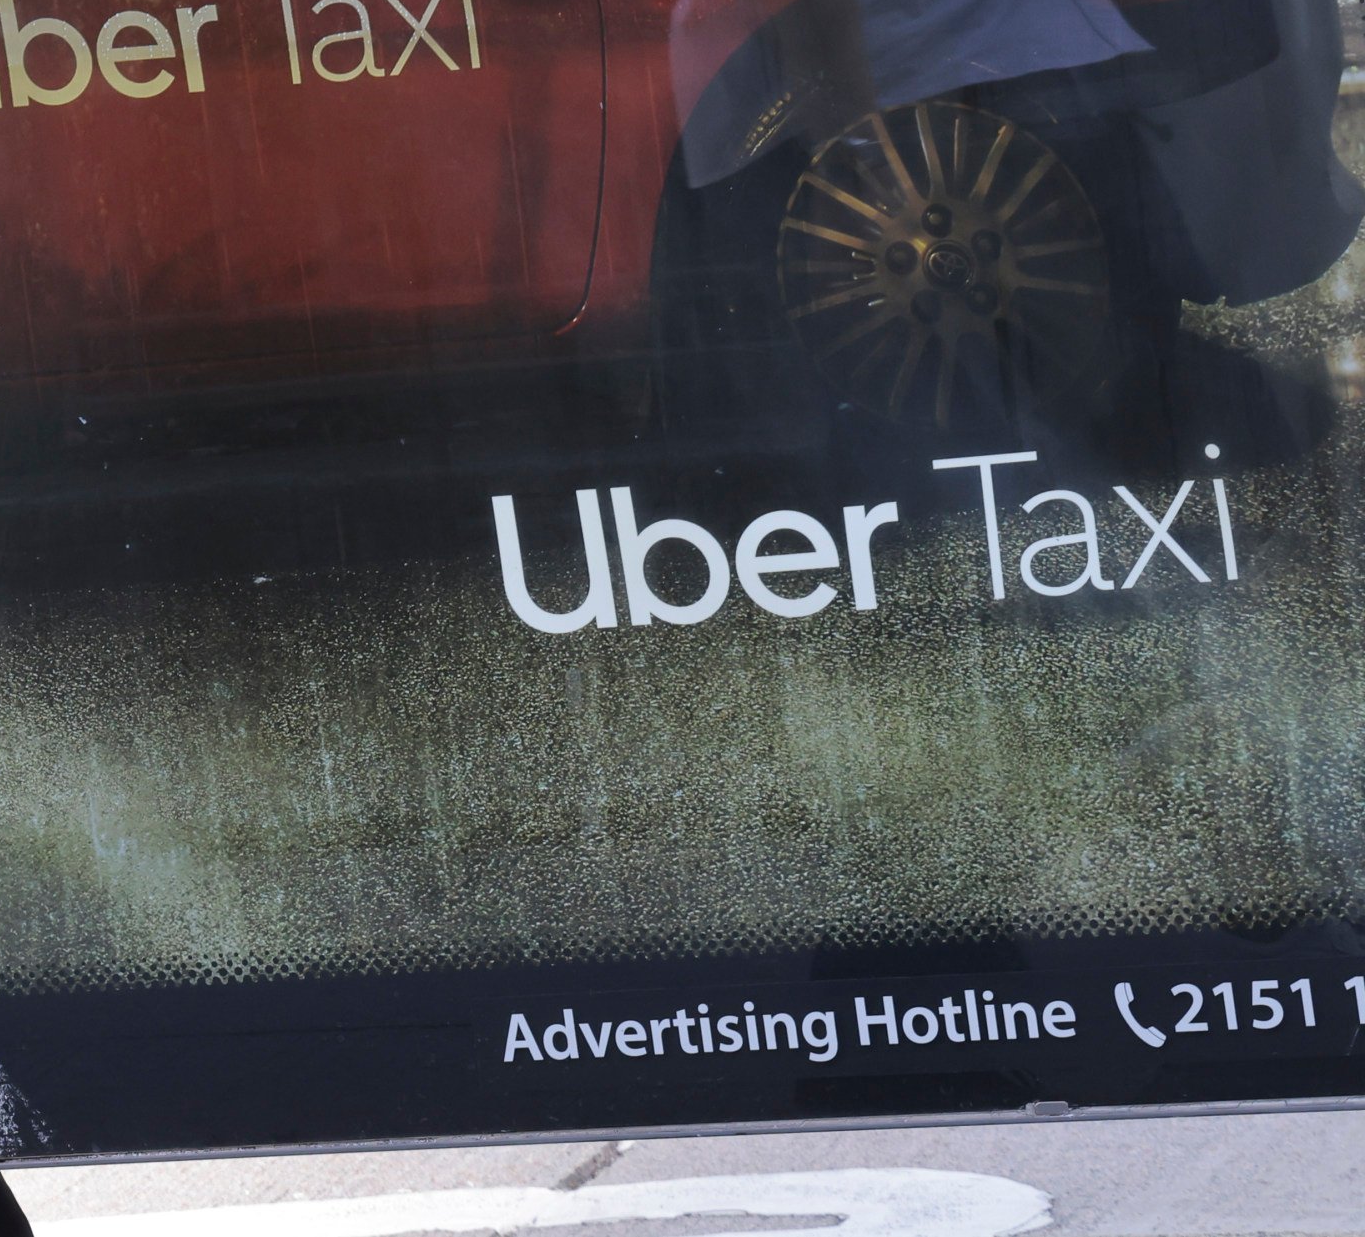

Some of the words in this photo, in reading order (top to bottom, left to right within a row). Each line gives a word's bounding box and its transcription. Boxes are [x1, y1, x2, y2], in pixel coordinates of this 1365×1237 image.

[491, 487, 899, 634] Uber
[932, 444, 1239, 601] Taxi
[503, 1002, 838, 1063] Advertising
[854, 989, 1076, 1046] Hotline
[1170, 978, 1316, 1033] 2151
